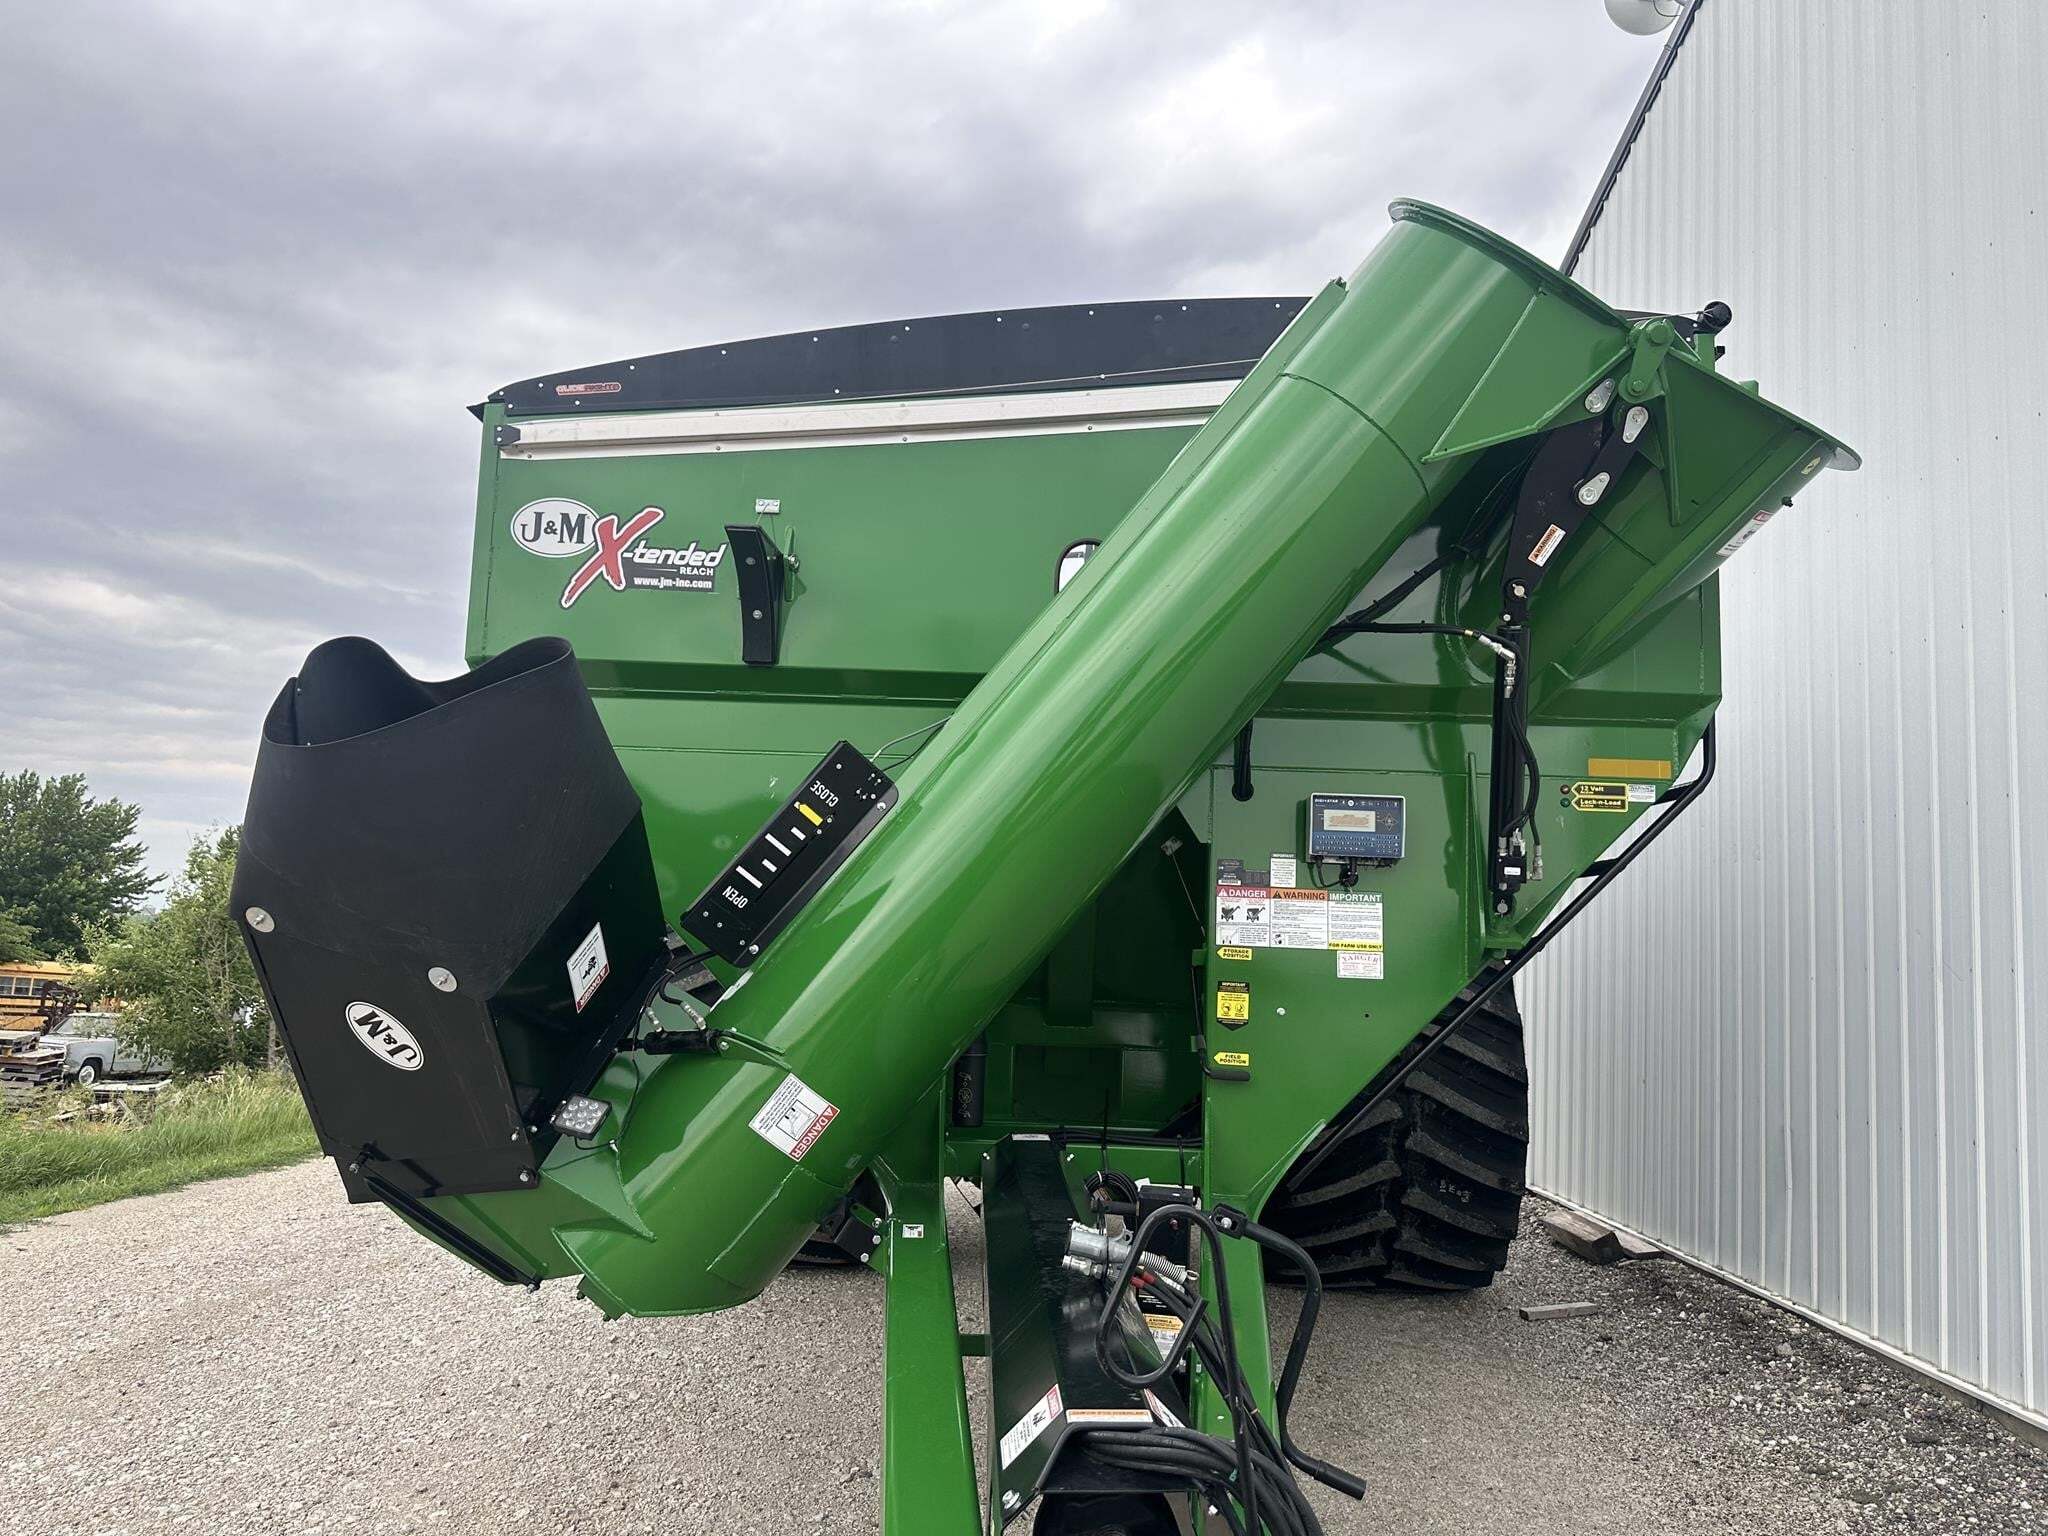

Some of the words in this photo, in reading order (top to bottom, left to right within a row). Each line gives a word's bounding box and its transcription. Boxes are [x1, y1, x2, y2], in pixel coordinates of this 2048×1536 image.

[520, 511, 588, 544] J&M
[679, 566, 714, 576] REACH
[633, 576, 713, 589] www.jm-inc.com
[809, 780, 839, 808] CLOSE
[722, 885, 749, 909] OPEN
[1228, 889, 1267, 898] DANGER
[1283, 891, 1326, 900] WARNING
[1329, 893, 1382, 902] IMPORTANT
[353, 1010, 418, 1063] J&M
[791, 1117, 829, 1158] DANGER
